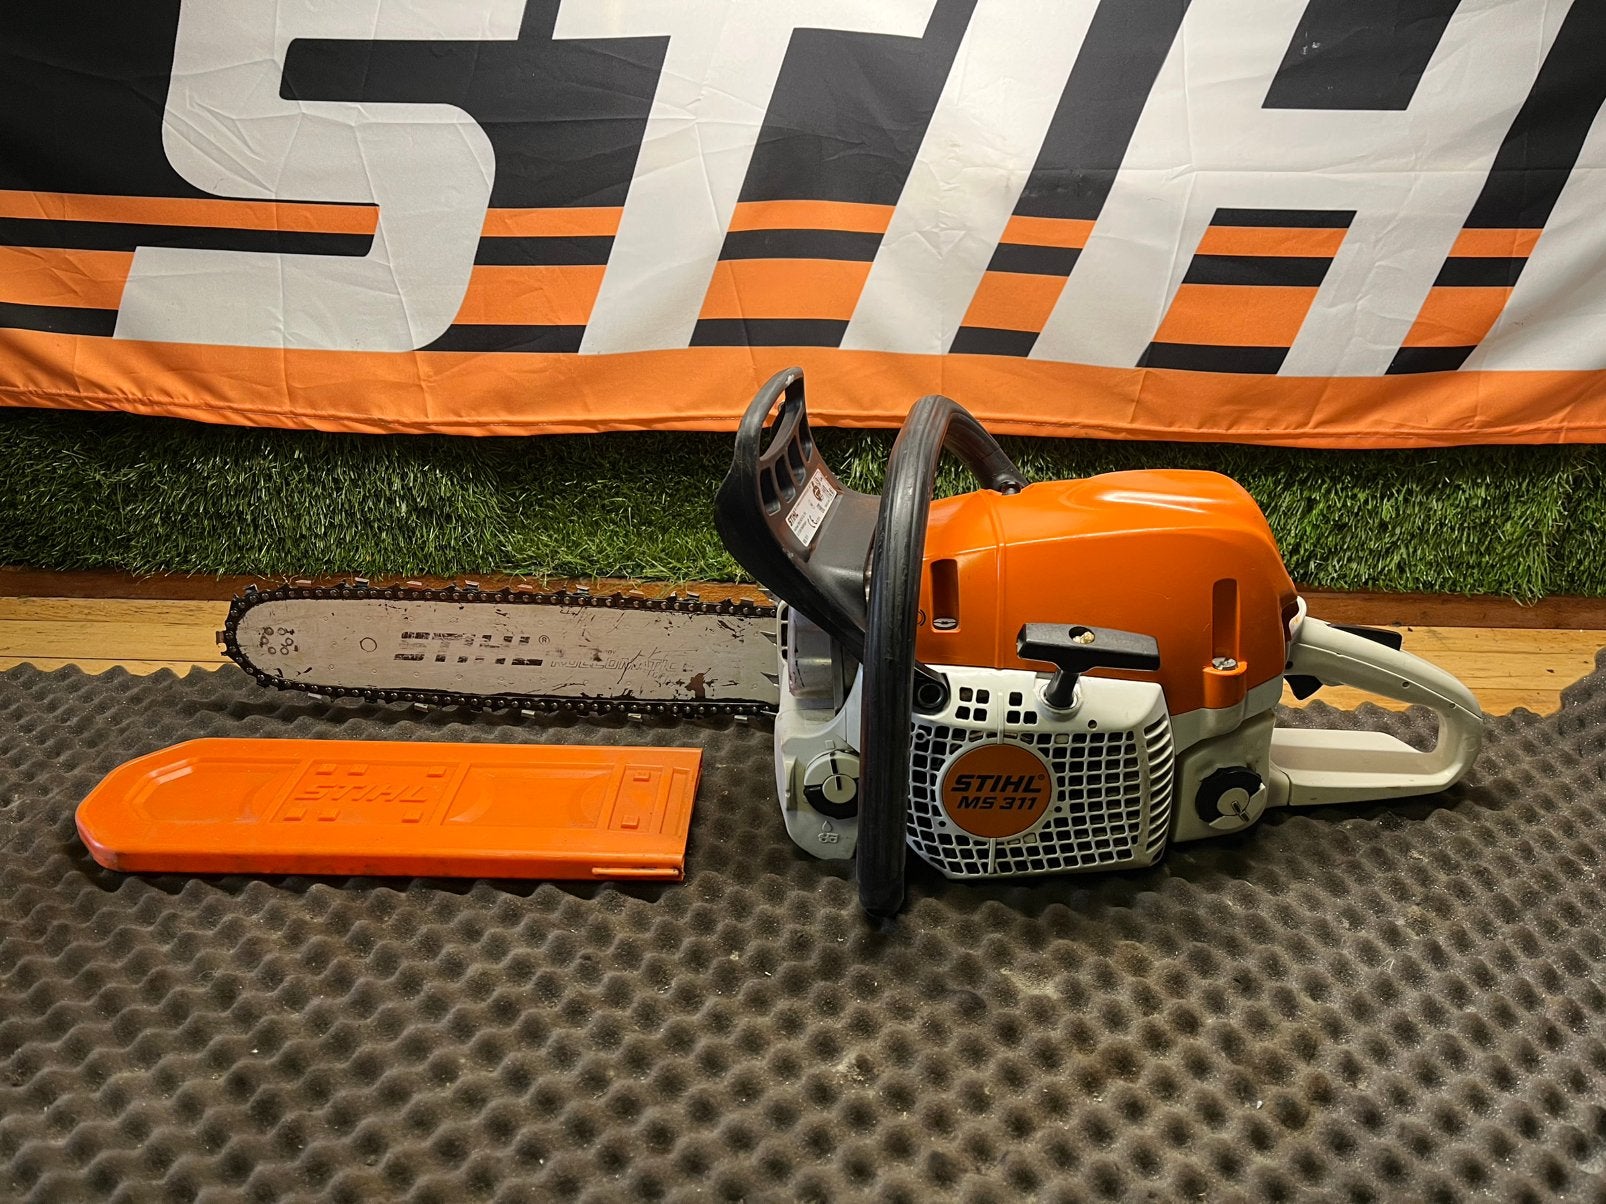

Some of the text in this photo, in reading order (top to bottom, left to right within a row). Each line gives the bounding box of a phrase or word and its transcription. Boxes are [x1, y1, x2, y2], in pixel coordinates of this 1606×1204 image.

[294, 784, 428, 803] STIHL
[957, 796, 1038, 811] MS 311
